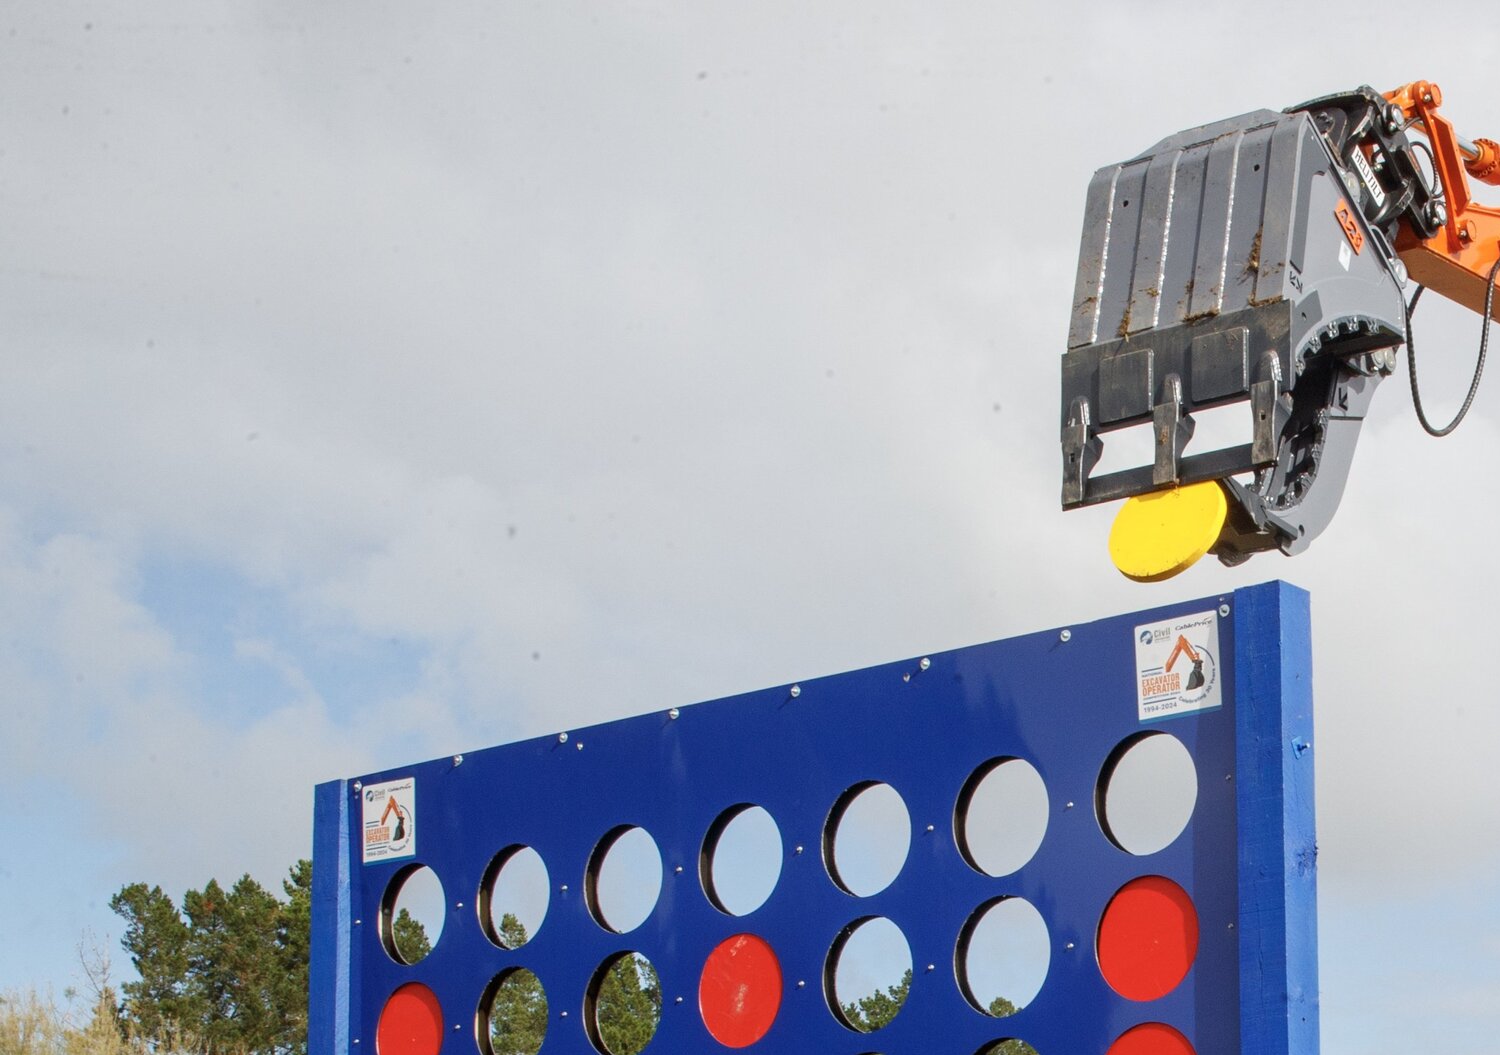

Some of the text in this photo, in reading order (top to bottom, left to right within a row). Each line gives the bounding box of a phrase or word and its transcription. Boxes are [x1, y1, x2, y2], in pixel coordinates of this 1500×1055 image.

[1154, 628, 1171, 638] Civil
[1142, 672, 1180, 688] EXCAVATOR
[1142, 681, 1181, 697] OPERATOR
[1144, 702, 1177, 712] 1994-2024
